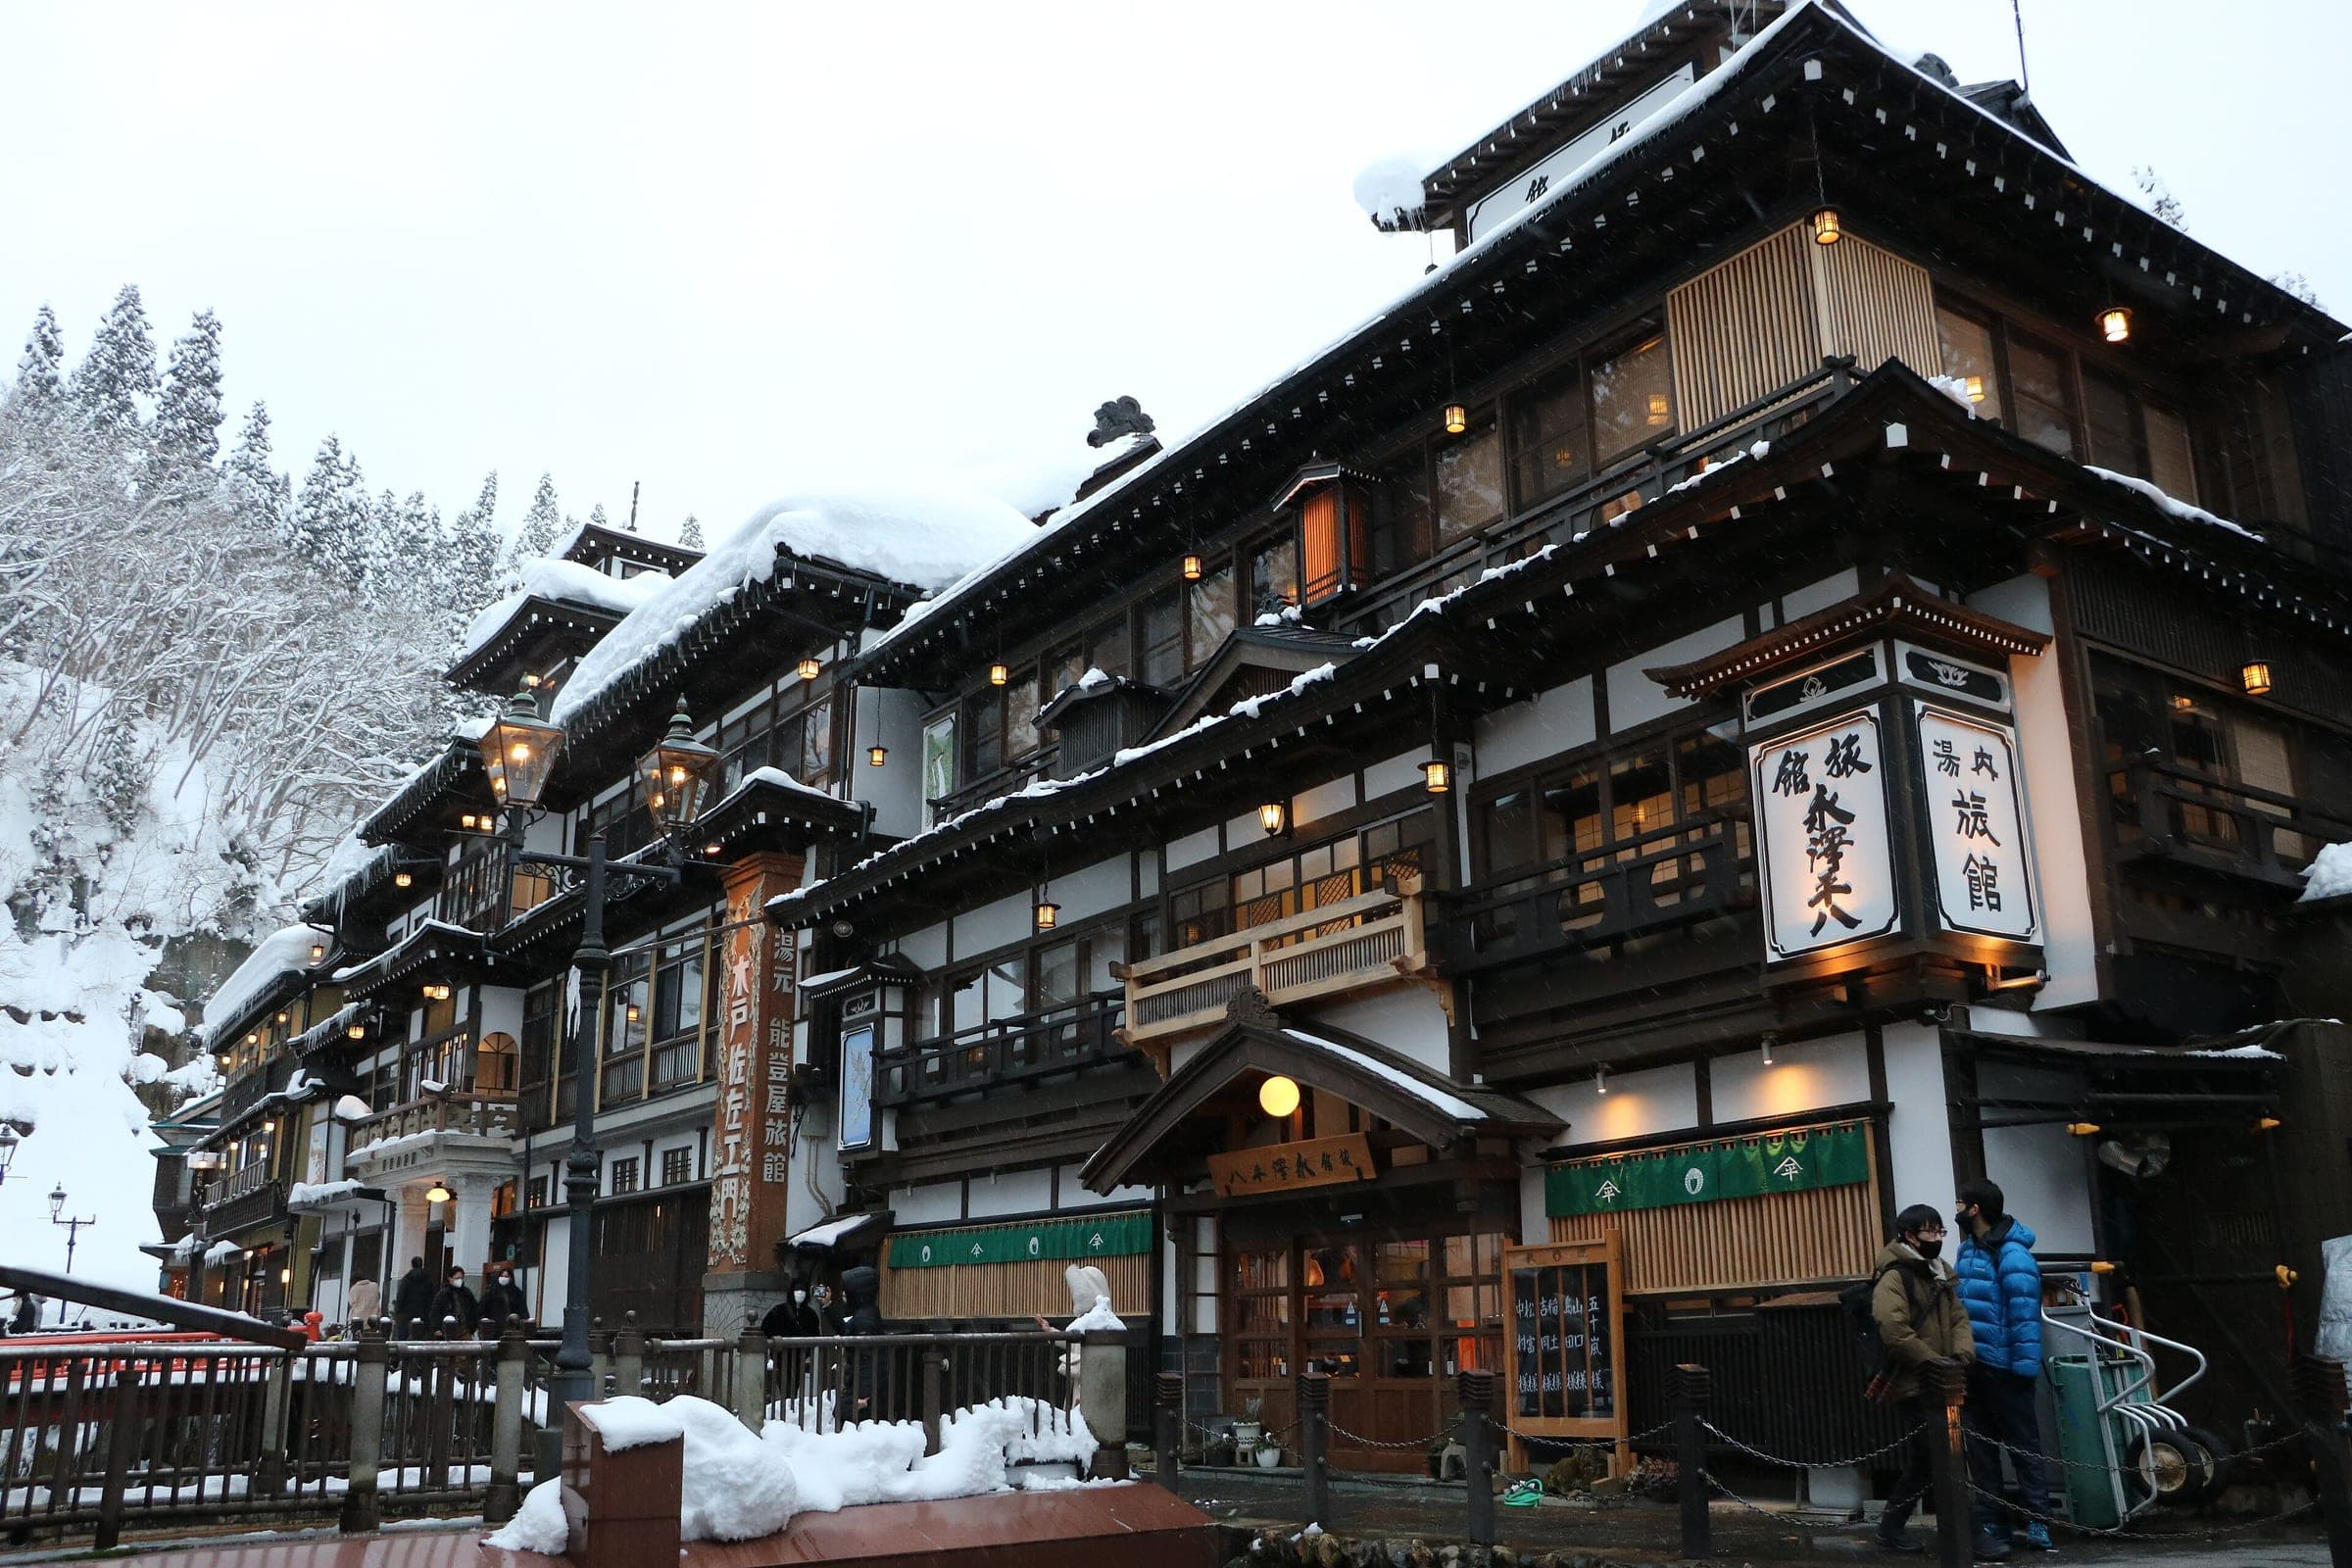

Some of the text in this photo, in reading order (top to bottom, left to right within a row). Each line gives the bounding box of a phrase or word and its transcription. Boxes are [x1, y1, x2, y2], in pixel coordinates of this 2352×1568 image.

[1952, 788, 2001, 912] 旅館
[762, 1017, 792, 1184] 能登屋旅館
